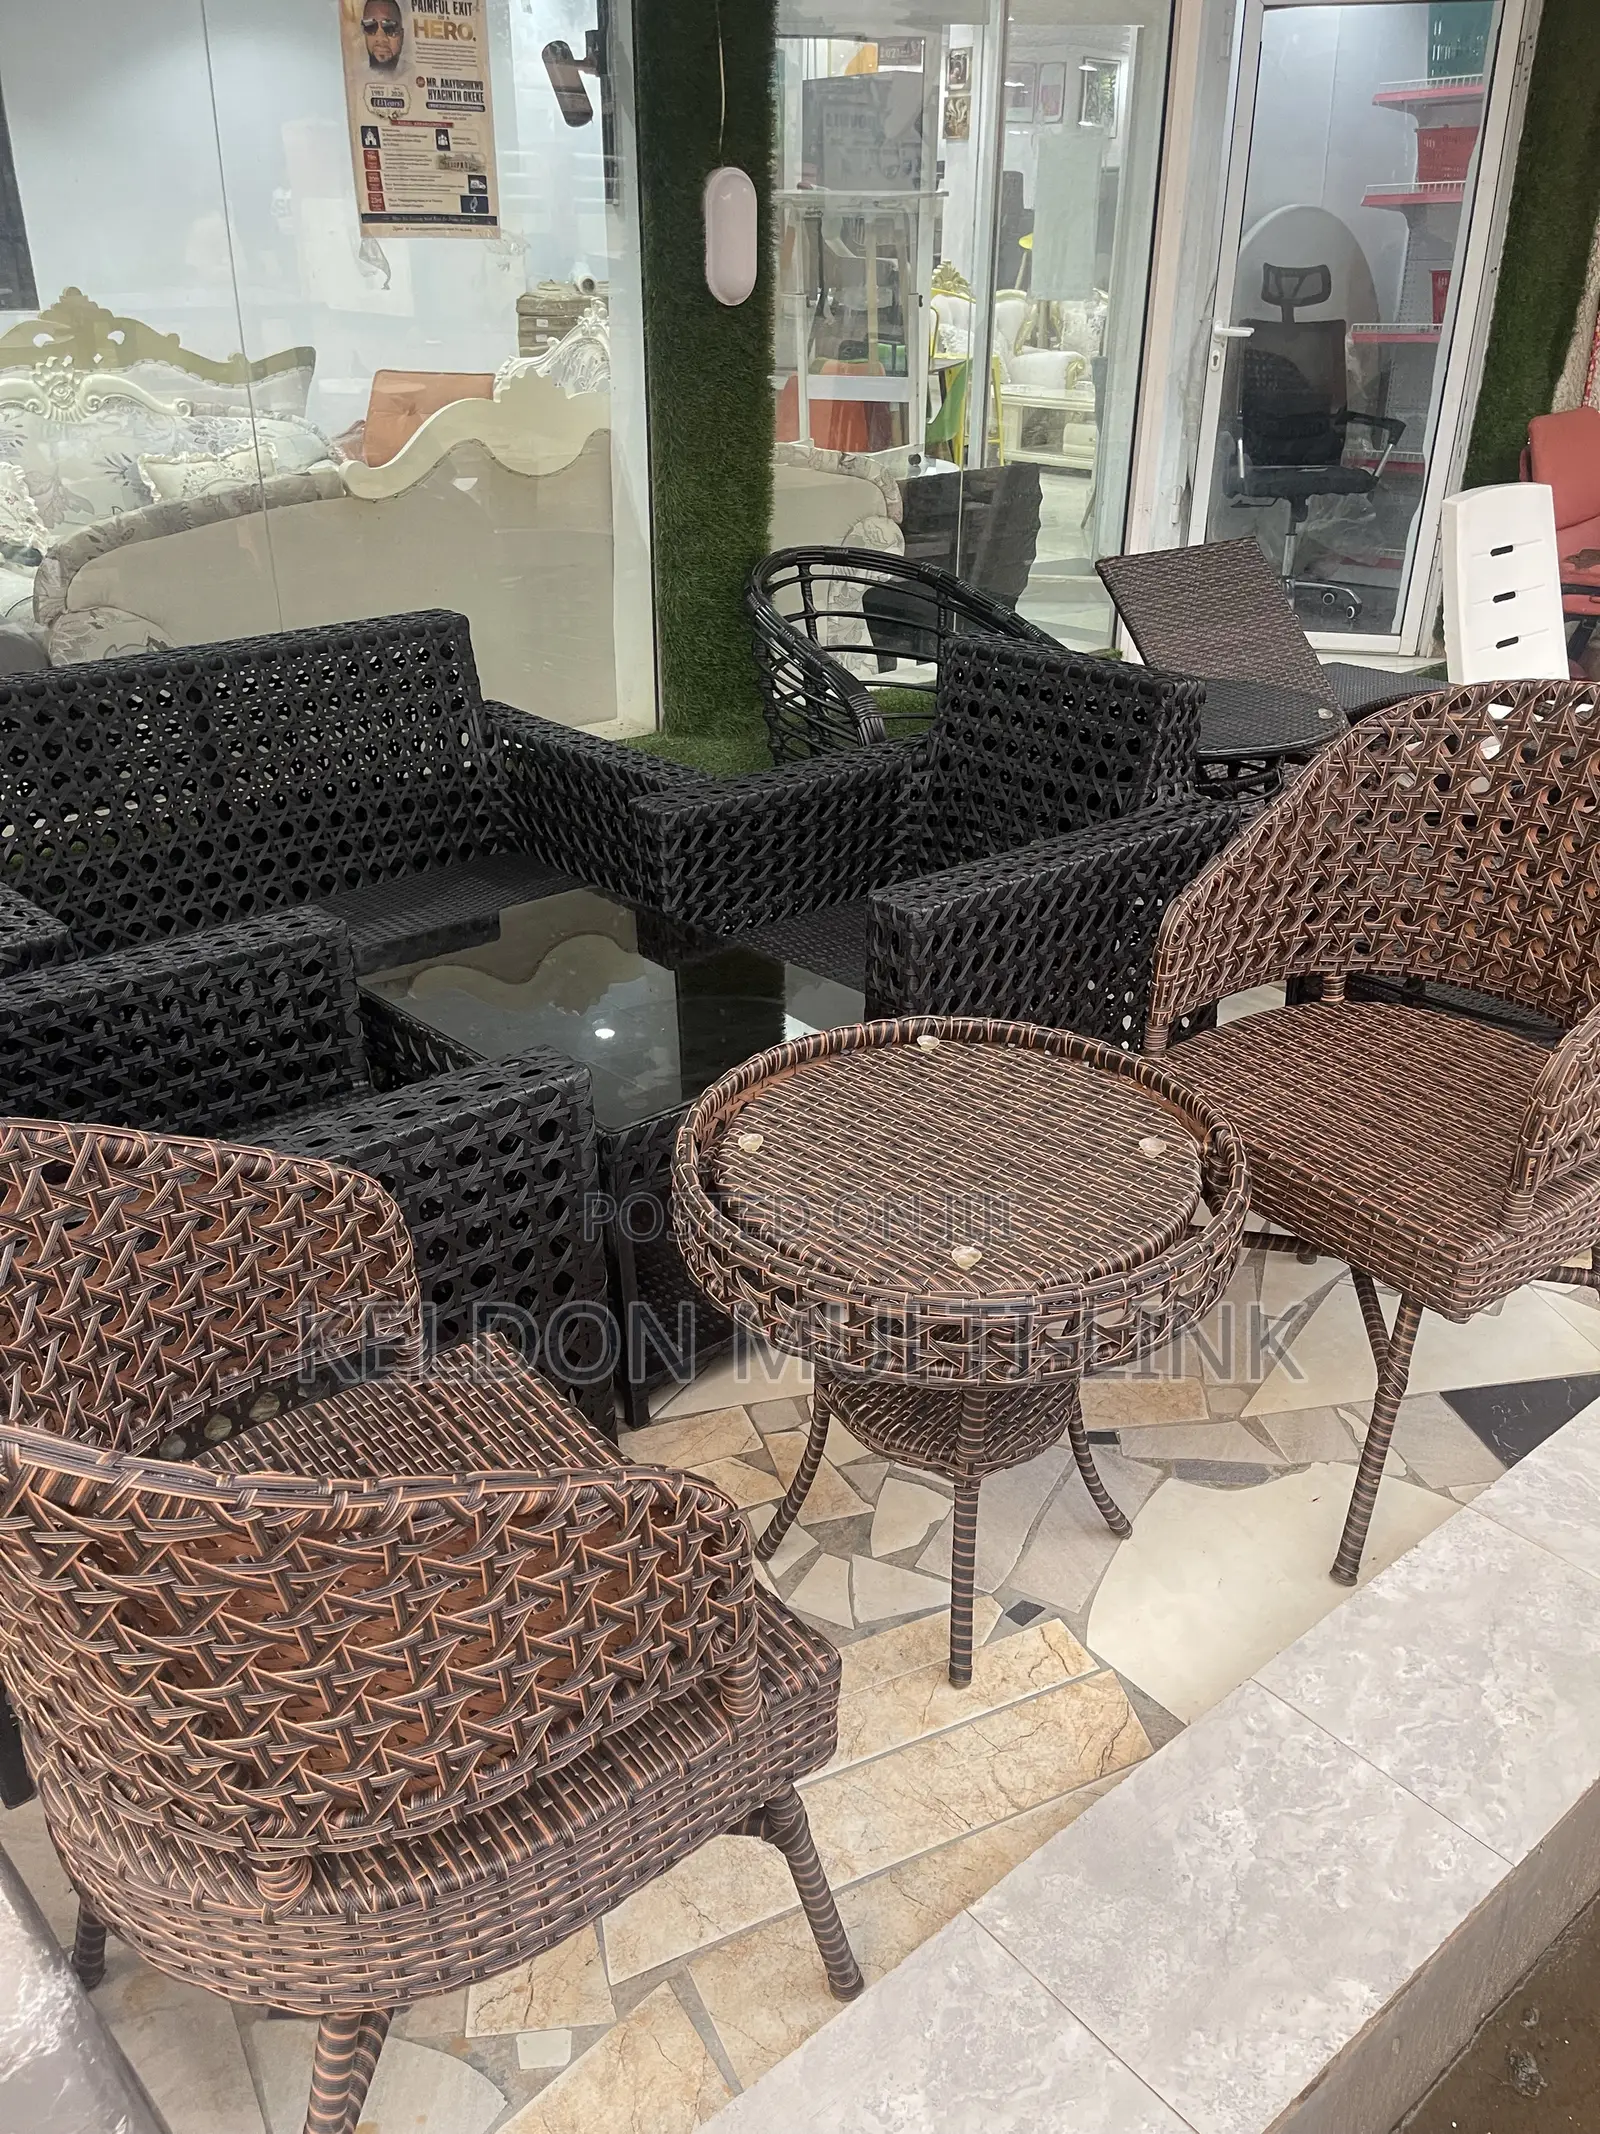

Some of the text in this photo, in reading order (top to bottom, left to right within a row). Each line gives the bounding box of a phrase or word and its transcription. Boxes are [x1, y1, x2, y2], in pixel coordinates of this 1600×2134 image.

[411, 0, 472, 16] PAINFUL EXIT
[413, 18, 476, 42] HERO.
[426, 77, 439, 88] MR.
[428, 88, 484, 103] HYACINTH OKEKE
